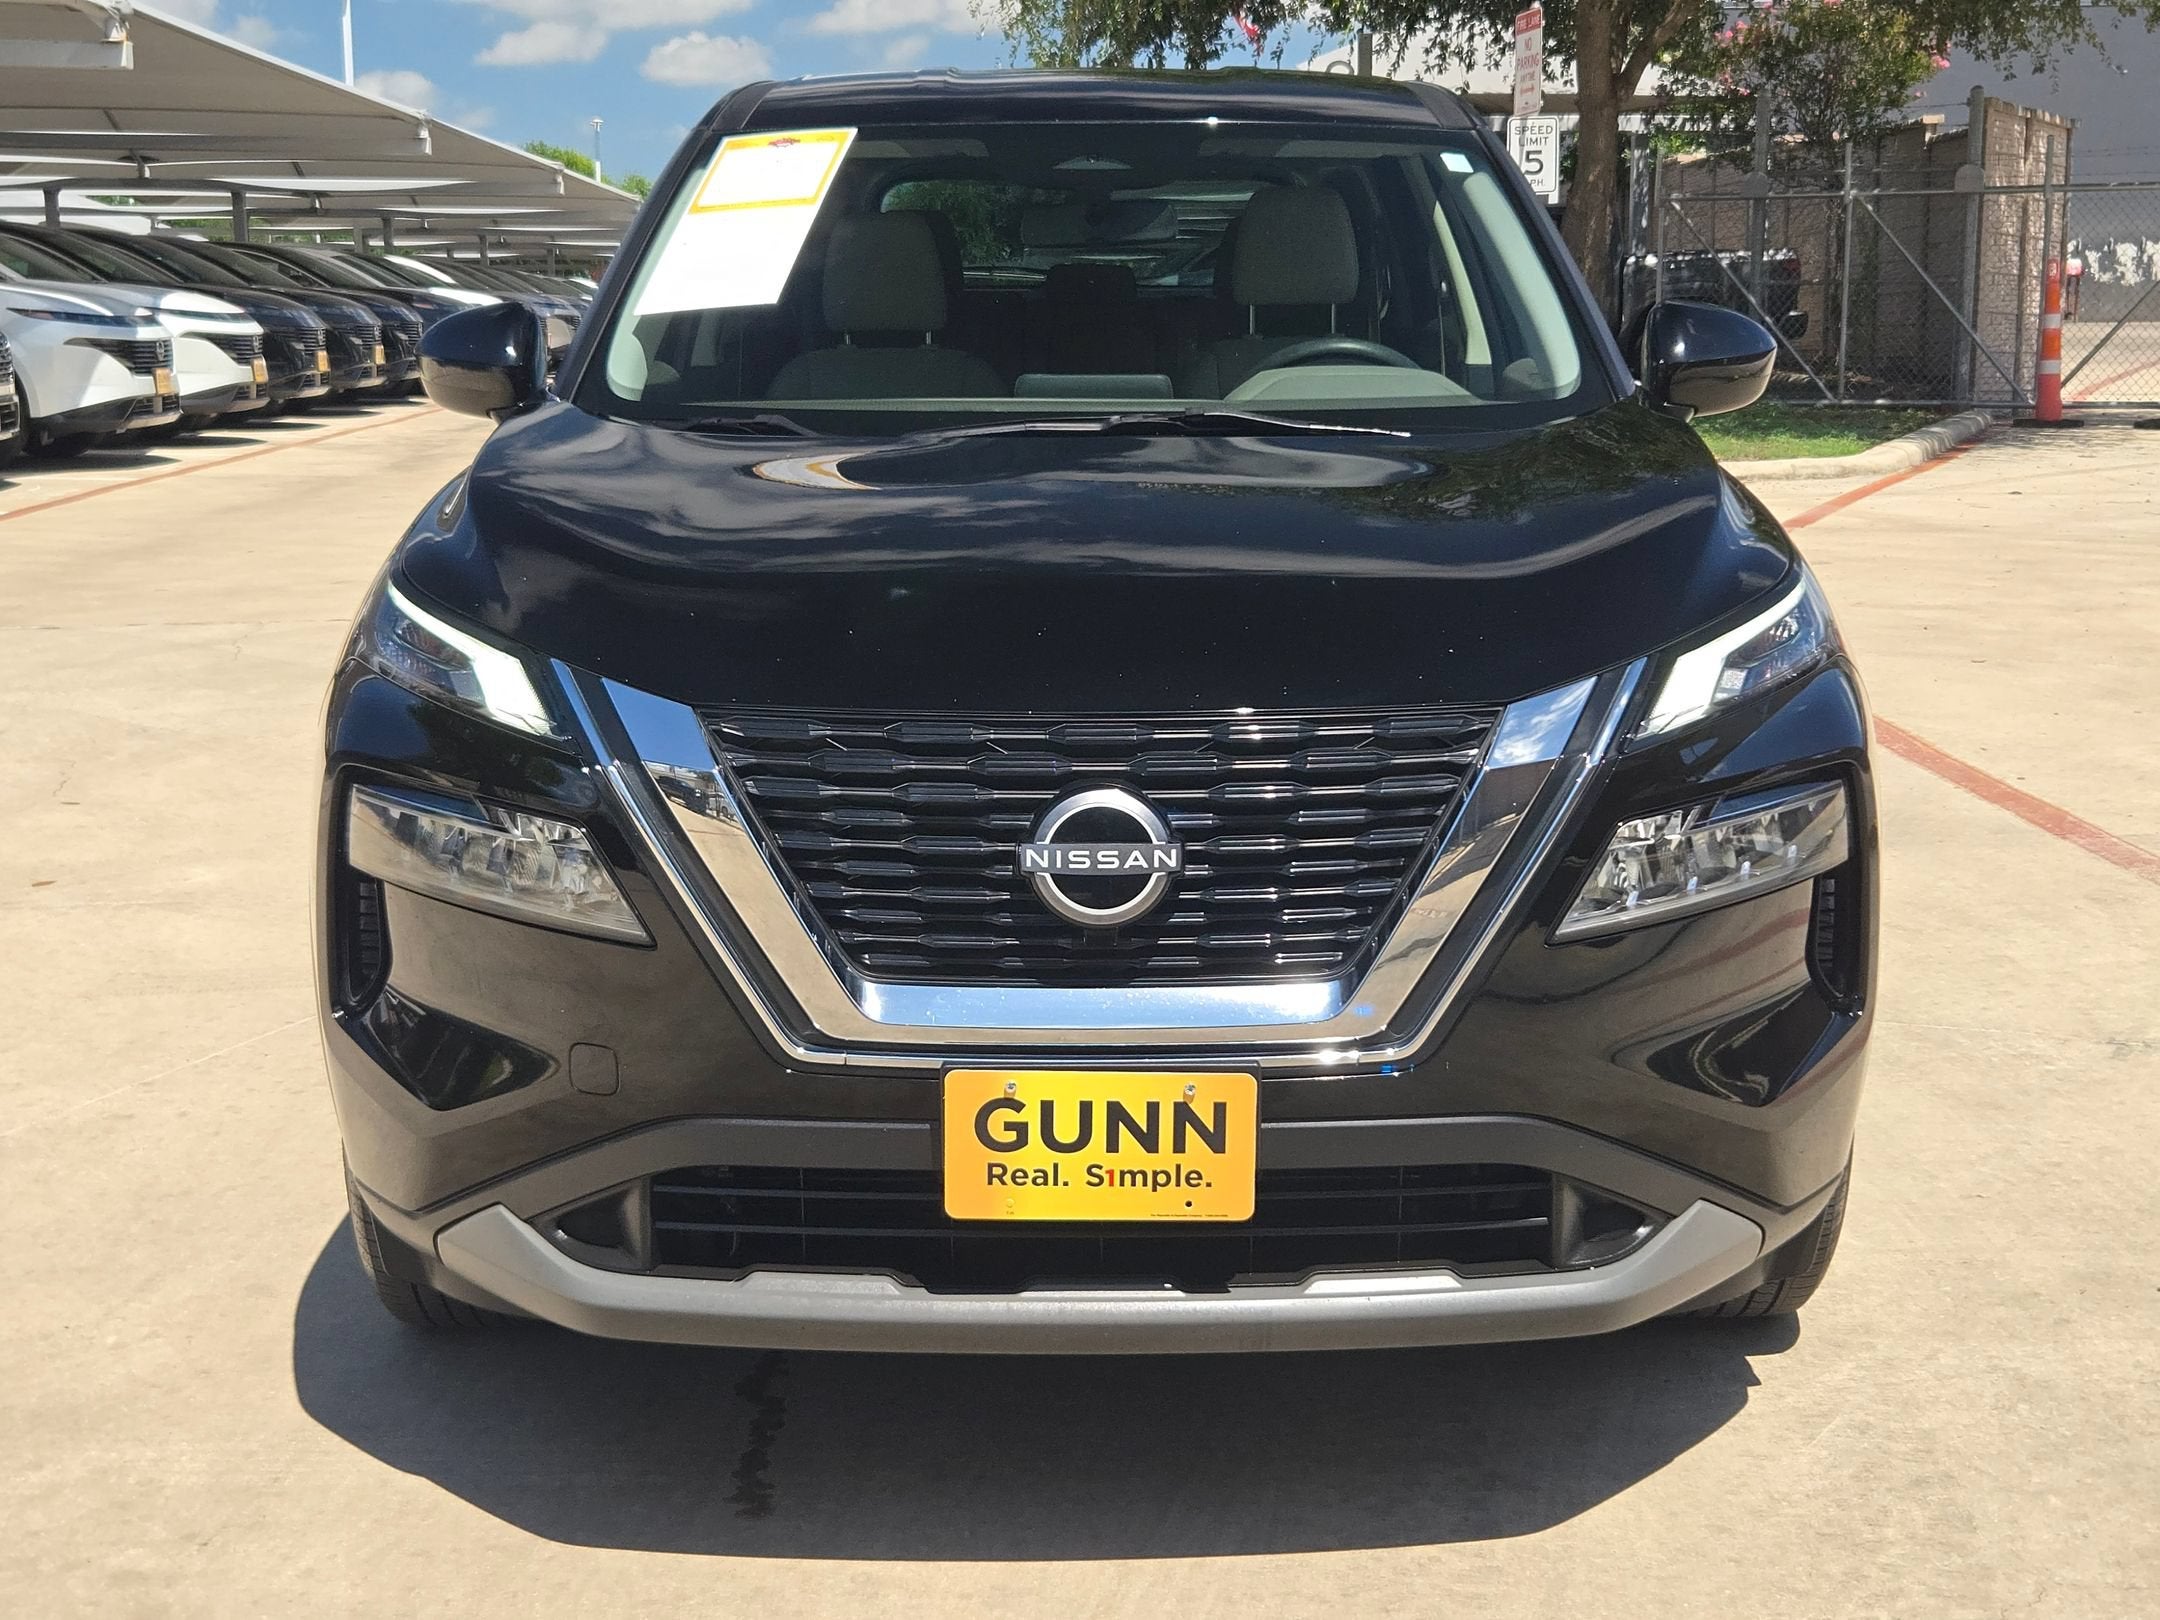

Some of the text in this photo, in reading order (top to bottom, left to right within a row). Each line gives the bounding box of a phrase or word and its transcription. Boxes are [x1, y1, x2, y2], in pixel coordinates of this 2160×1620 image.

[1527, 14, 1541, 27] LANE
[1524, 37, 1533, 51] NO
[1517, 53, 1539, 70] PARKING
[1514, 125, 1553, 136] SPEED
[1519, 136, 1549, 147] LIMIT
[1523, 150, 1544, 175] 5
[1025, 848, 1177, 869] NISSAN
[974, 1097, 1227, 1154] GUNN
[986, 1162, 1069, 1188] Real.
